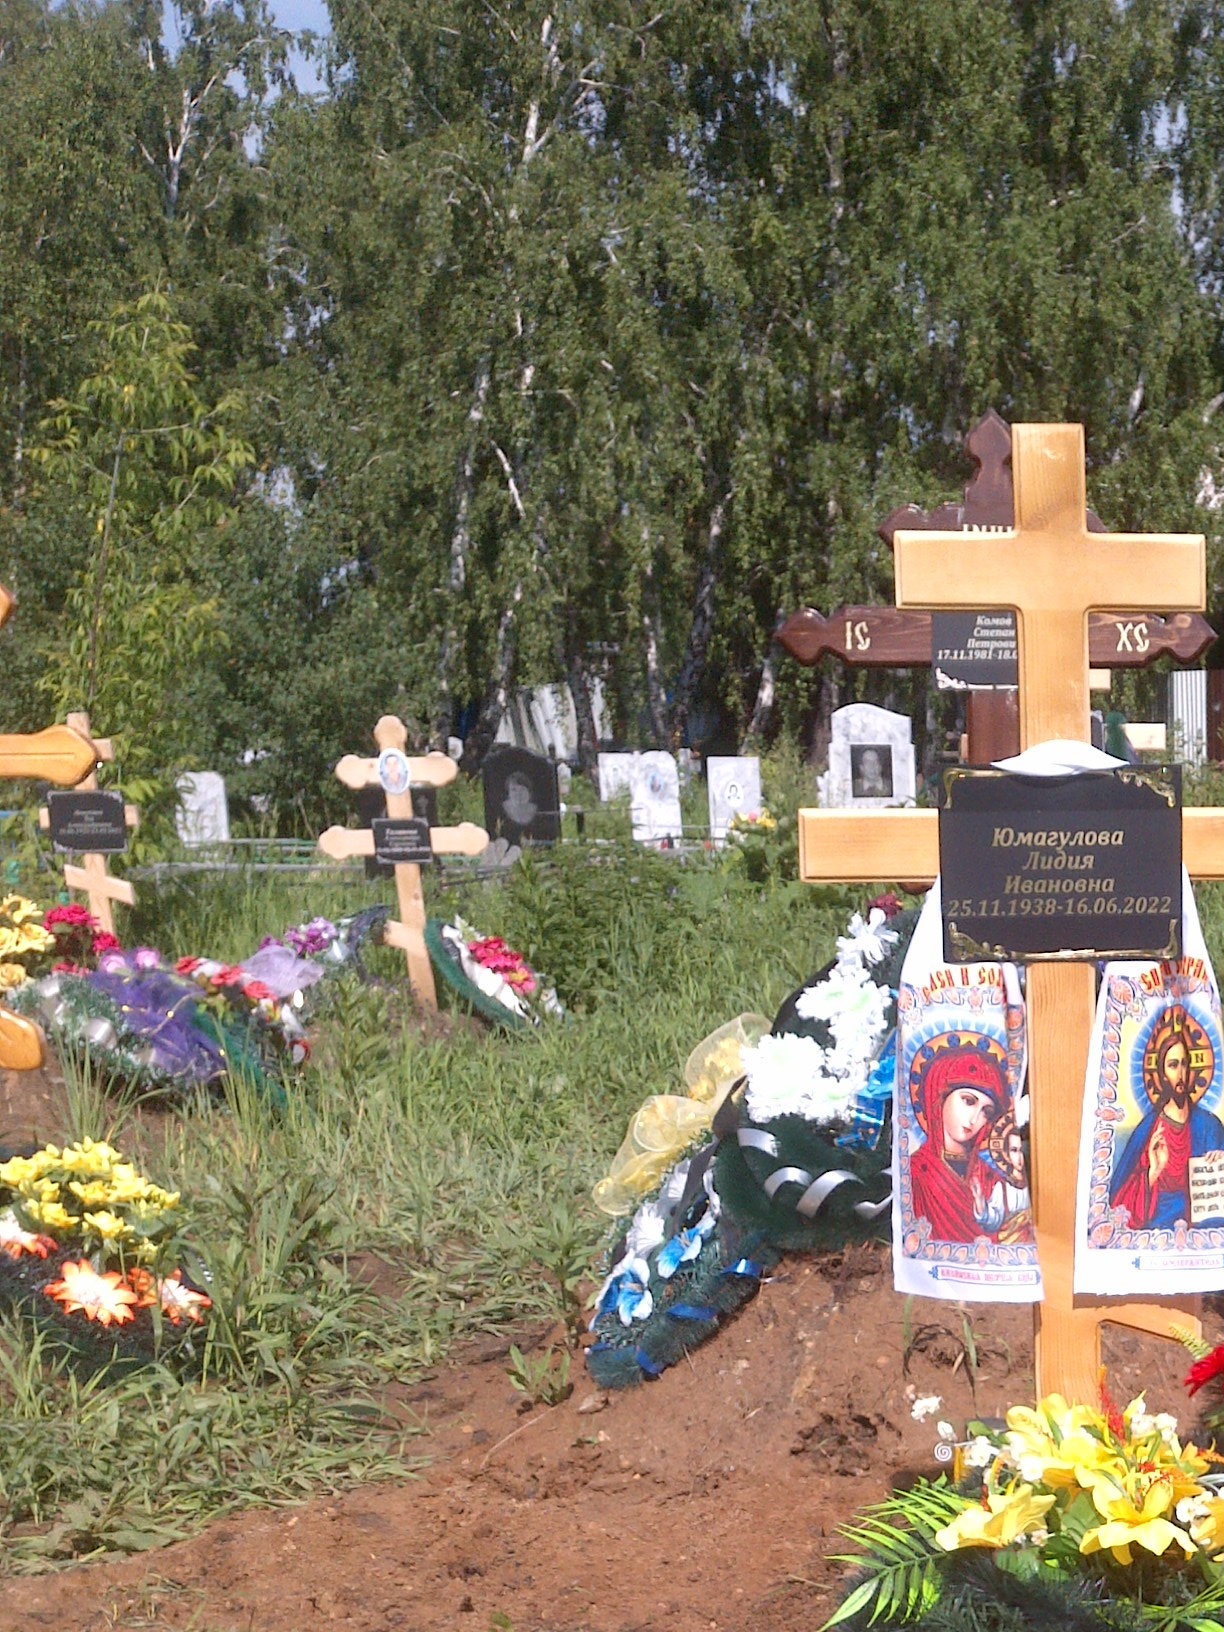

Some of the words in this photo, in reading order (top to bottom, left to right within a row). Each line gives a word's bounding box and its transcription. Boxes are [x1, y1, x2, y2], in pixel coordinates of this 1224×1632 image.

[973, 627, 1016, 637] Степан
[966, 638, 1017, 649] Петрови
[991, 827, 1125, 850] Юмагулова
[1022, 850, 1095, 870] Лидия
[1004, 875, 1115, 894] Ивановна
[947, 896, 1172, 917] 25.11.1938-16.06.2022
